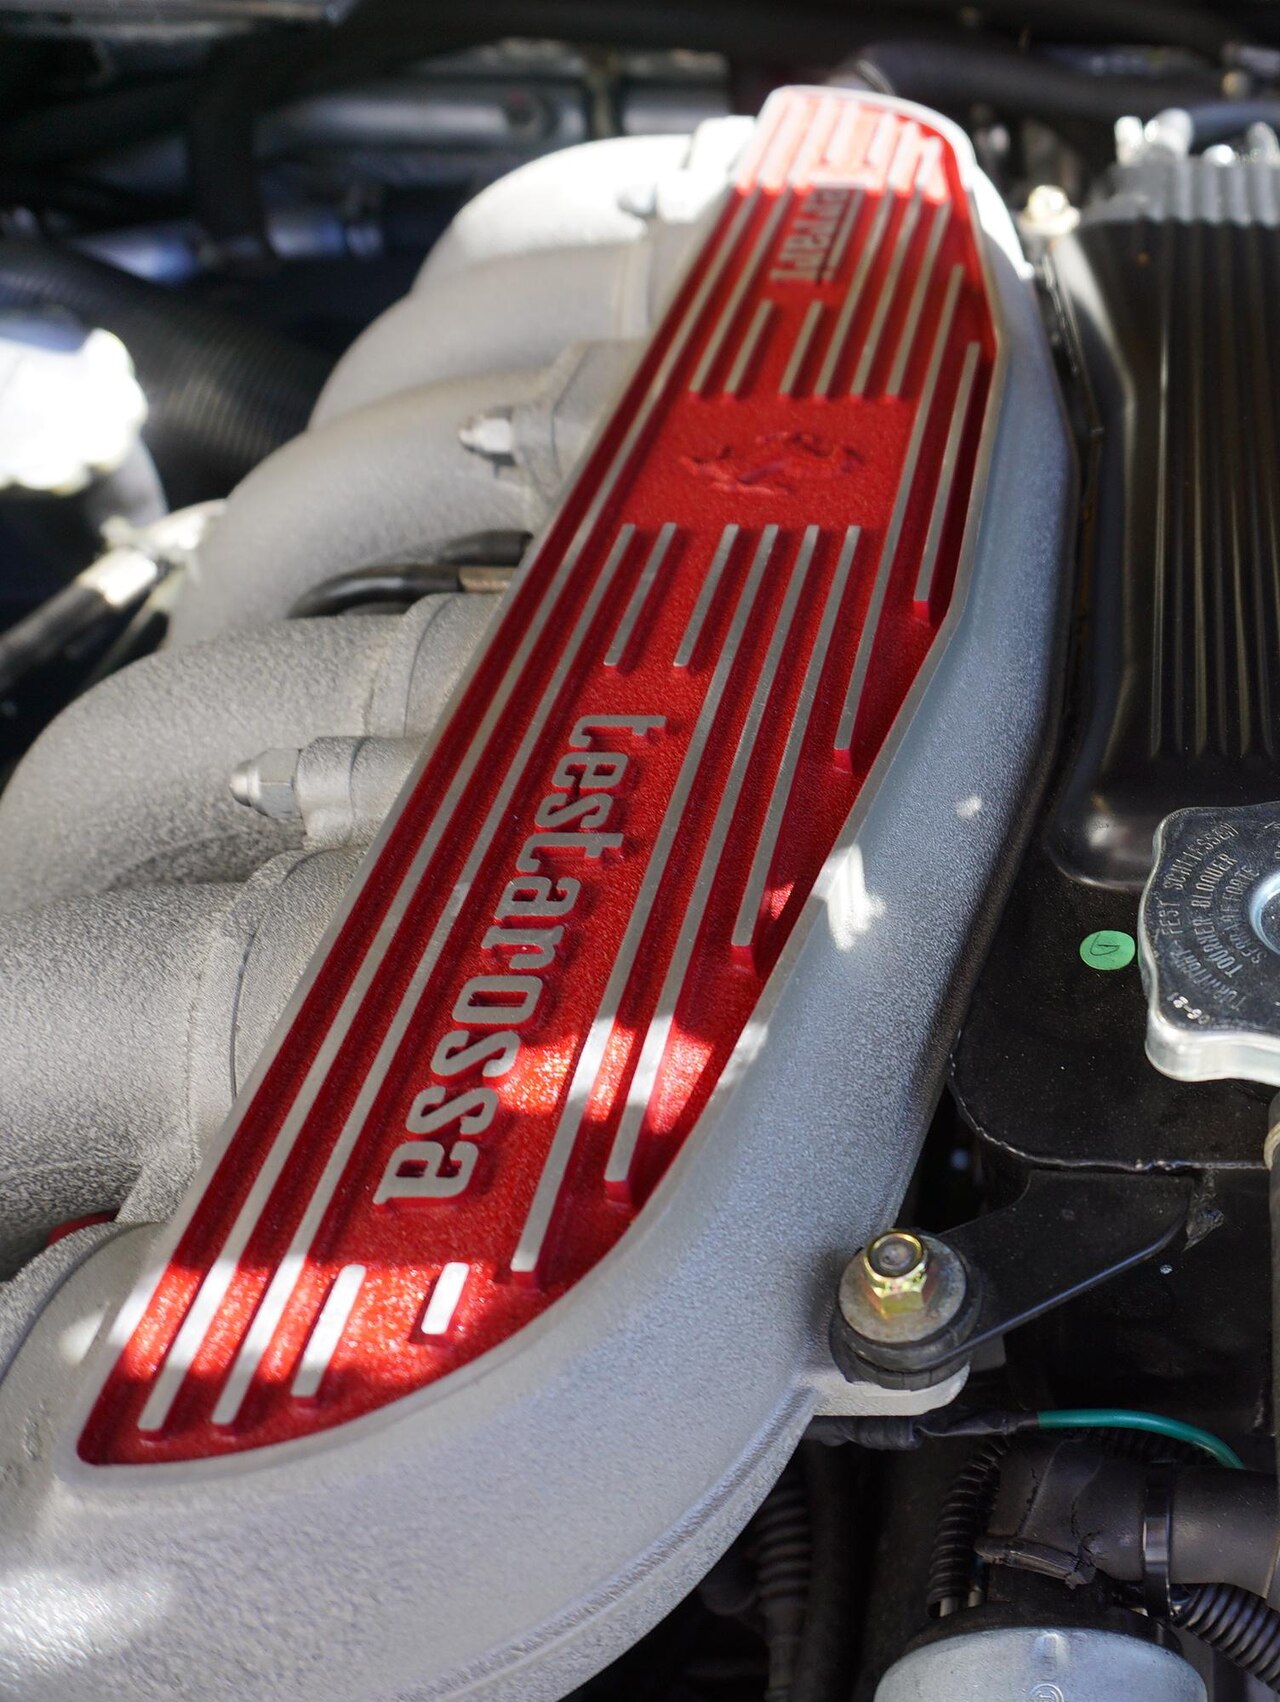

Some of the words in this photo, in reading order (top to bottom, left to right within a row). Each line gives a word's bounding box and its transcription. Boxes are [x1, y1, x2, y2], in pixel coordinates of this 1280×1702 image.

[1191, 853, 1238, 908] BLOQUER
[1222, 865, 1260, 901] FORTE
[373, 713, 667, 1206] testarossa
